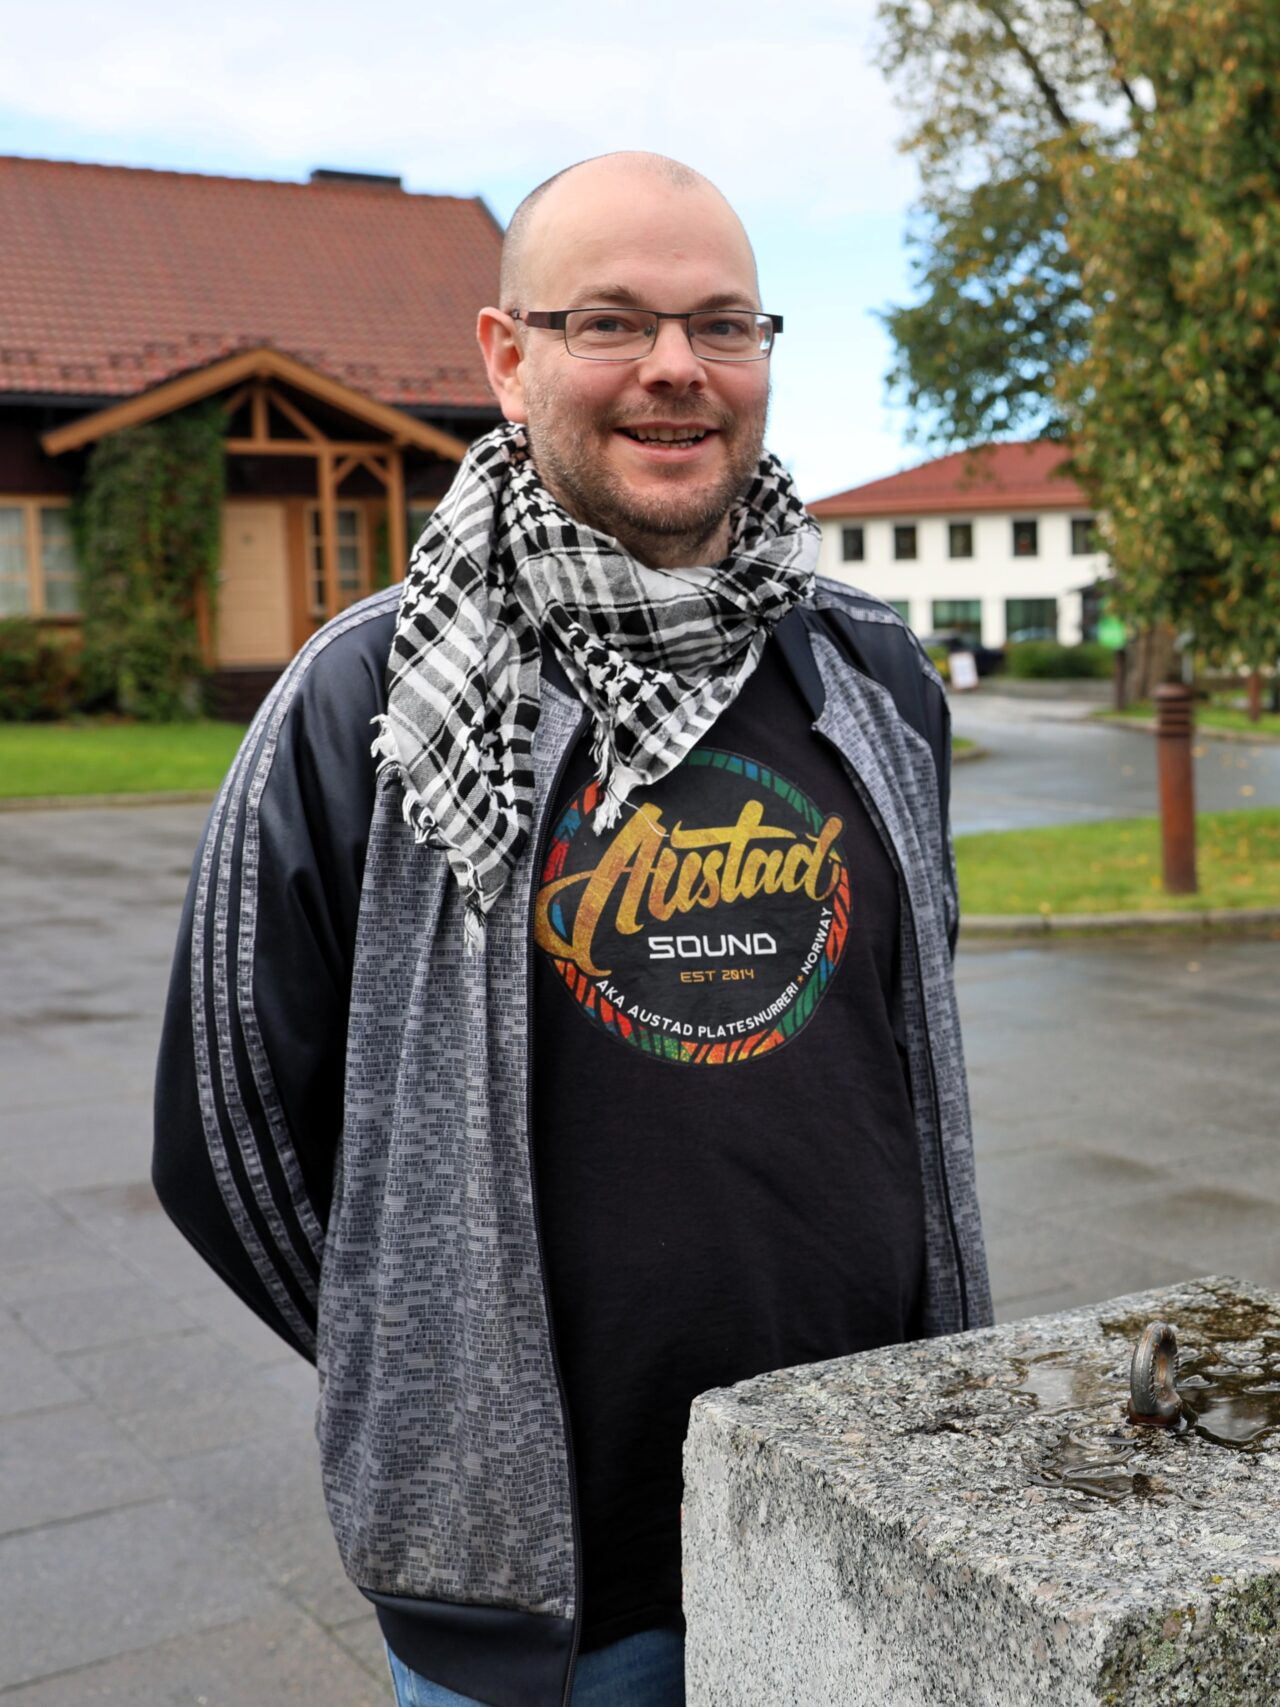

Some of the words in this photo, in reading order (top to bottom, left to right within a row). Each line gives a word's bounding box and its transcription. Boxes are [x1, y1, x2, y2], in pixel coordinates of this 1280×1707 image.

[534, 799, 843, 977] Austad
[595, 979, 625, 1009] AKA
[627, 1004, 693, 1037] AUSTAD
[698, 982, 799, 1038] PLATESNURRERI
[801, 906, 833, 975] NORWAY
[648, 932, 777, 960] SOUND
[680, 970, 716, 983] EST
[721, 968, 755, 981] 2014
